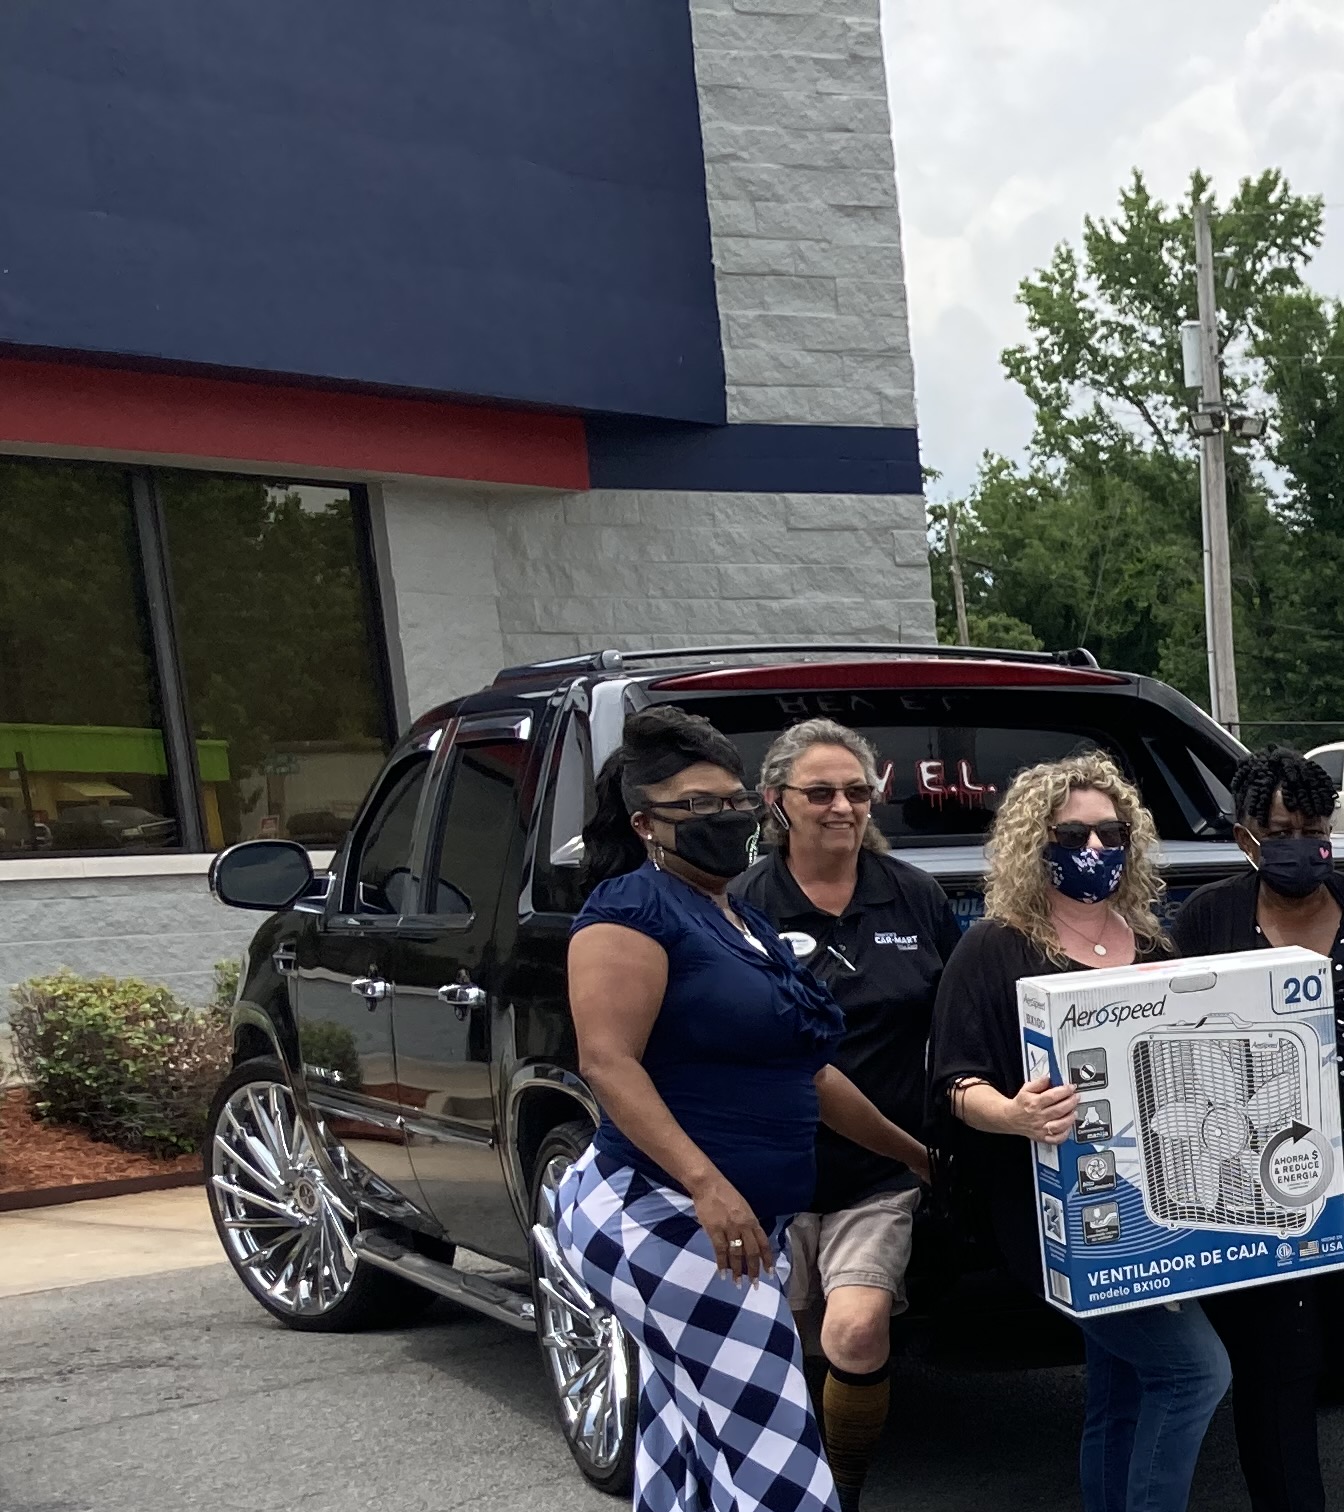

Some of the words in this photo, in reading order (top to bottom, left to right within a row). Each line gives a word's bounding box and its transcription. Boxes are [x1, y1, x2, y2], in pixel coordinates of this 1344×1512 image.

[875, 935, 918, 944] CAR-MART
[1059, 994, 1167, 1030] Aerospeed
[1274, 1154, 1309, 1166] AHORRA
[1283, 1161, 1319, 1173] REDUCE
[1322, 1241, 1344, 1253] USA
[1087, 1254, 1196, 1287] VENTILADOR
[1200, 1249, 1222, 1266] DE
[1227, 1241, 1268, 1261] CAJA
[1089, 1286, 1130, 1302] modelo
[1133, 1277, 1171, 1294] BX100
